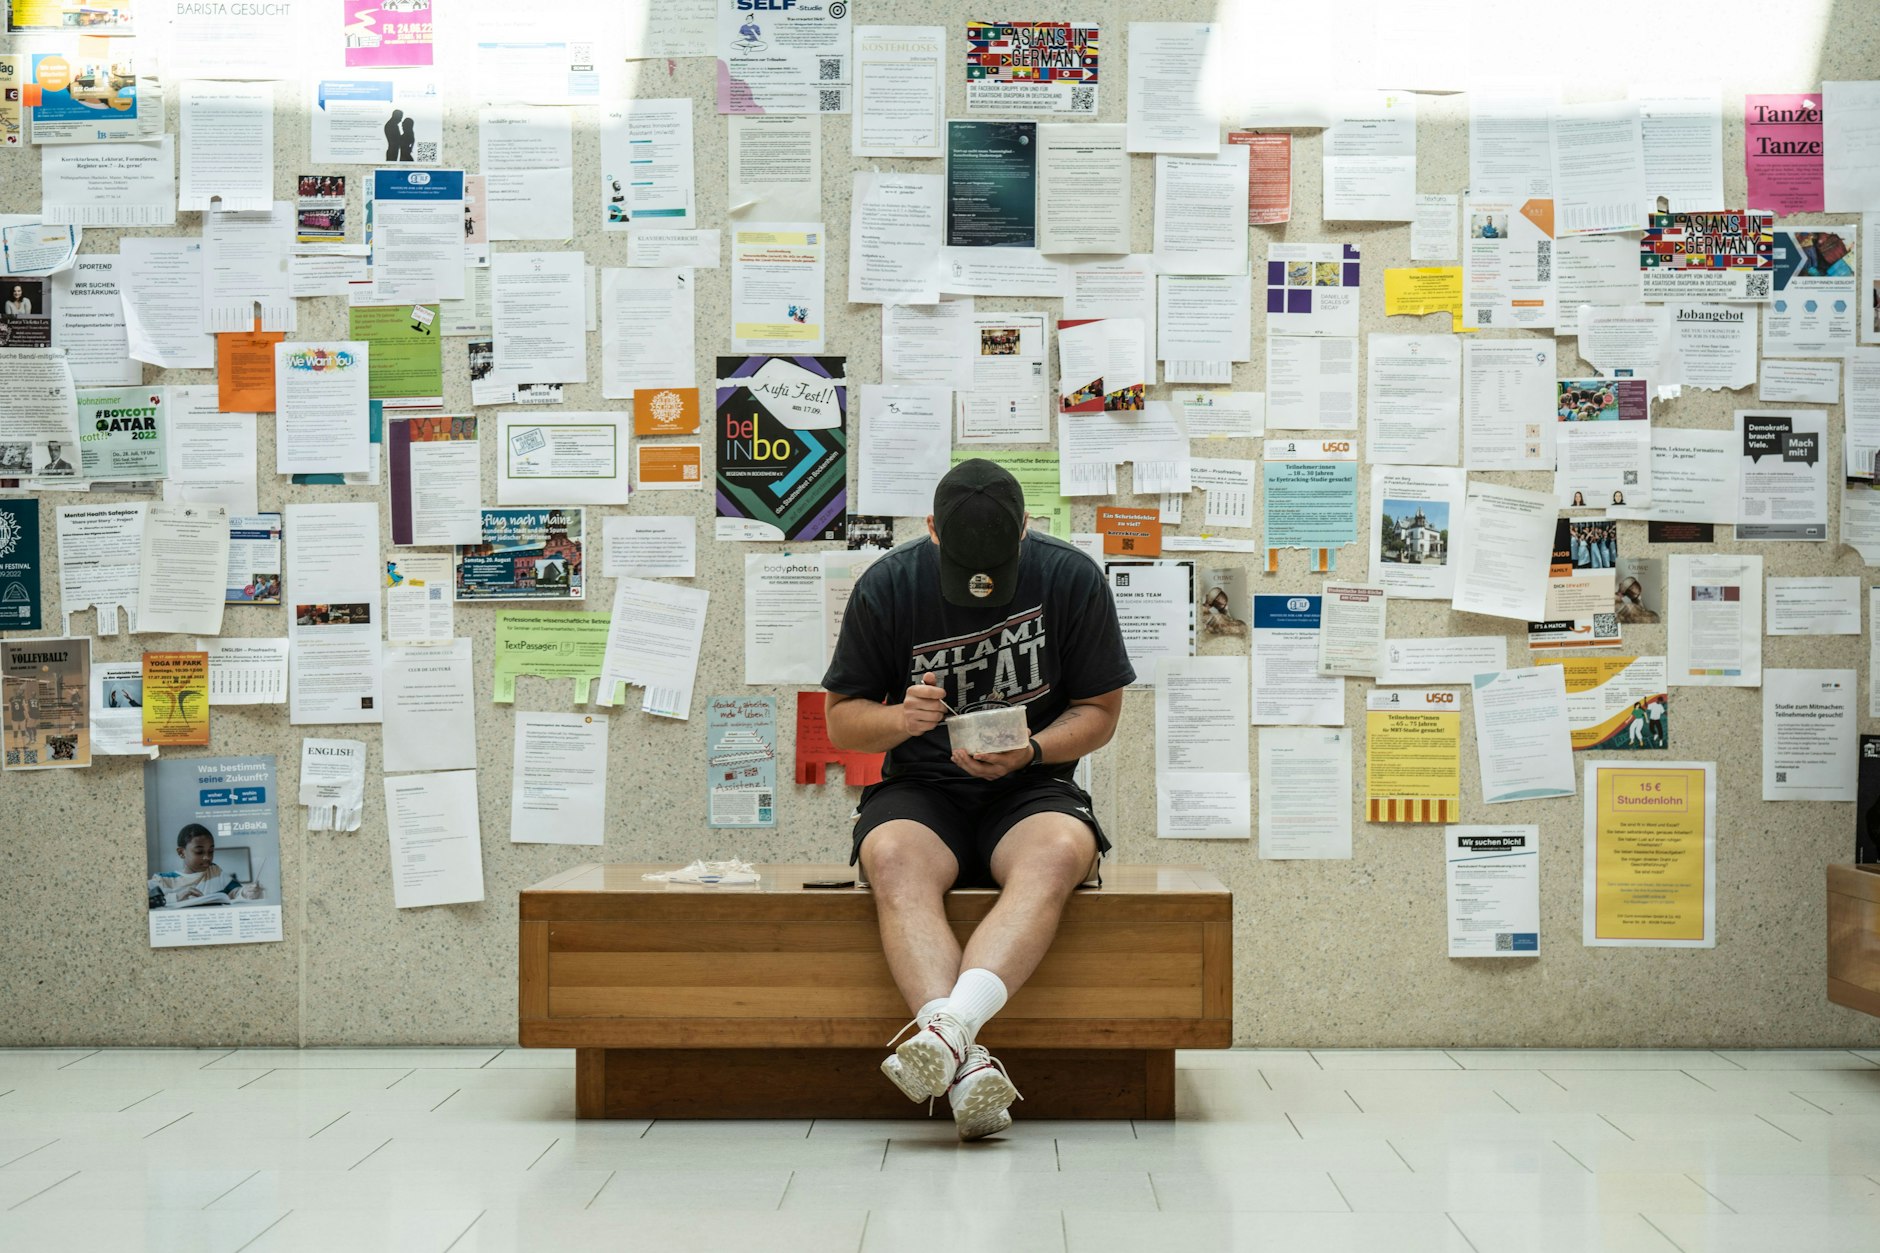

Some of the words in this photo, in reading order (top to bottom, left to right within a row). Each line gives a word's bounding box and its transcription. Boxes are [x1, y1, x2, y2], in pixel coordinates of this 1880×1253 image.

[177, 3, 227, 15] BARISTA
[231, 3, 291, 16] GESUCHT
[737, 0, 797, 11] SELF
[1012, 28, 1066, 46] ASIANS
[1074, 28, 1088, 46] IN
[862, 43, 938, 52] KOSTENLOSES
[1012, 50, 1087, 68] GERMANY
[1685, 215, 1740, 233] ASIANS
[1748, 215, 1761, 233] IN
[1685, 237, 1759, 254] GERMANY
[70, 288, 120, 296] VERSTÄRKUNG!
[1676, 309, 1744, 321] Jobangebot
[288, 356, 305, 366] We
[306, 355, 333, 366] Want
[335, 354, 356, 366] You!
[96, 407, 157, 419] #BOYCOTT
[803, 404, 822, 416] 17.09.
[96, 418, 156, 432] QATAR
[1749, 424, 1789, 432] Demokratie
[132, 431, 157, 440] 2022
[1789, 439, 1814, 448] Mach
[1789, 448, 1808, 456] mit!
[775, 504, 785, 515] das
[808, 474, 815, 483] in
[812, 450, 840, 478] Bockenheim
[64, 511, 86, 519] Mental
[108, 509, 139, 517] Safeplace
[510, 513, 536, 525] nach
[540, 513, 574, 525] Mainz
[497, 534, 521, 542] jüdischer
[764, 564, 819, 574] bodyphoton
[504, 640, 557, 652] TextPassagen
[912, 615, 1046, 672] MIAMI
[11, 652, 68, 664] VOLLEYBALL?
[150, 659, 171, 667] YOGA
[172, 659, 181, 667] IM
[182, 659, 202, 667] PARK
[720, 710, 737, 719] mehr
[1817, 711, 1844, 719] gesucht!
[308, 747, 354, 757] ENGLISH
[198, 765, 218, 773] Was
[220, 763, 265, 772] bestimmt
[198, 775, 223, 784] seine
[225, 773, 269, 783] Zukunft?
[1640, 782, 1652, 792] 15
[1655, 782, 1661, 792] €
[1617, 795, 1683, 805] Stundenlohn
[233, 821, 268, 831] ZuBaKa
[1474, 838, 1501, 846] suchen
[1503, 838, 1522, 846] Dich!
